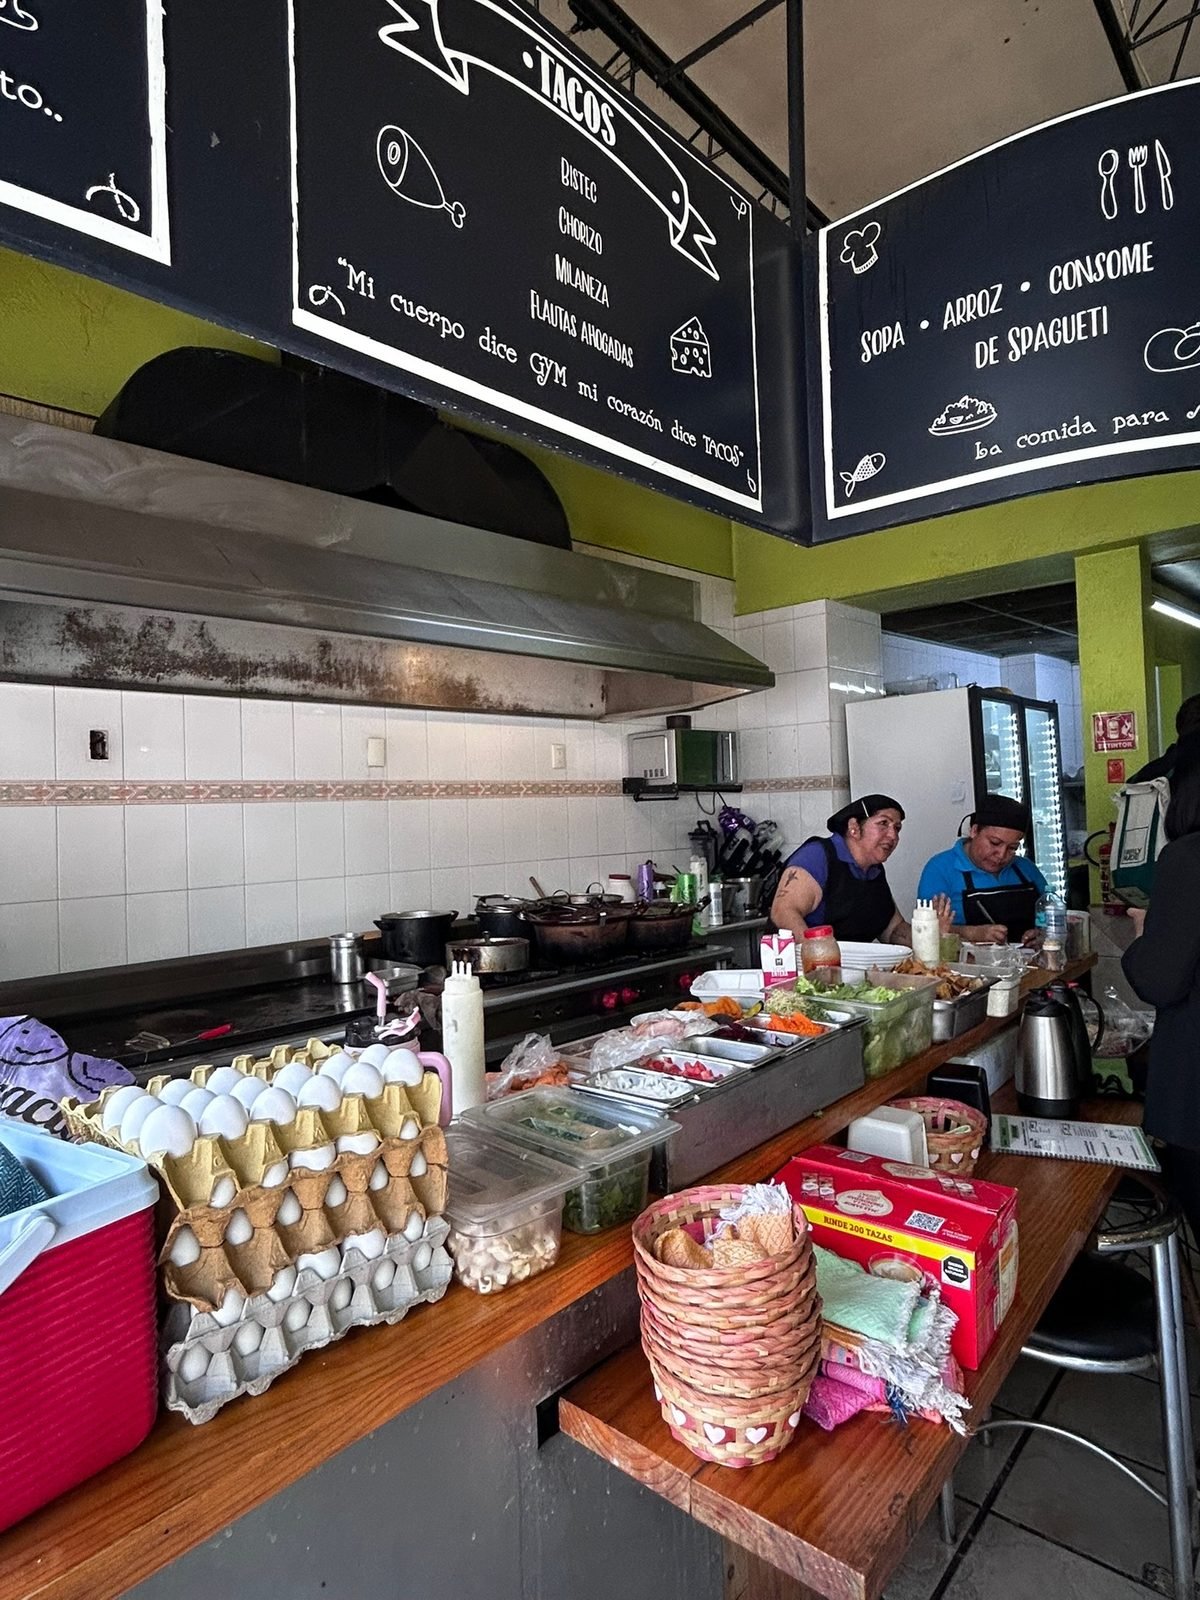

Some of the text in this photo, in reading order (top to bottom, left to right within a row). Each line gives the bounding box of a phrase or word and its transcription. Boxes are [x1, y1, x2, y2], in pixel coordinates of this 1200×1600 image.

[535, 46, 617, 147] TACOS
[560, 157, 598, 204] BISTEC
[558, 206, 603, 255] CHORIZO
[555, 253, 610, 308] MILANEZA
[861, 241, 1155, 363] SOPA ARROZ CONSOME
[530, 289, 634, 369] FLAUTAS AHOGADAS
[975, 306, 1109, 369] DE SPAGUETI
[390, 294, 465, 340] cuerpo
[478, 326, 518, 364] dice
[578, 381, 599, 402] mi
[606, 396, 664, 433] corazón
[671, 419, 697, 447] dice
[1016, 415, 1098, 448] comida
[1112, 410, 1170, 435] para
[823, 1215, 893, 1243] RINDE 200 TAZAS
